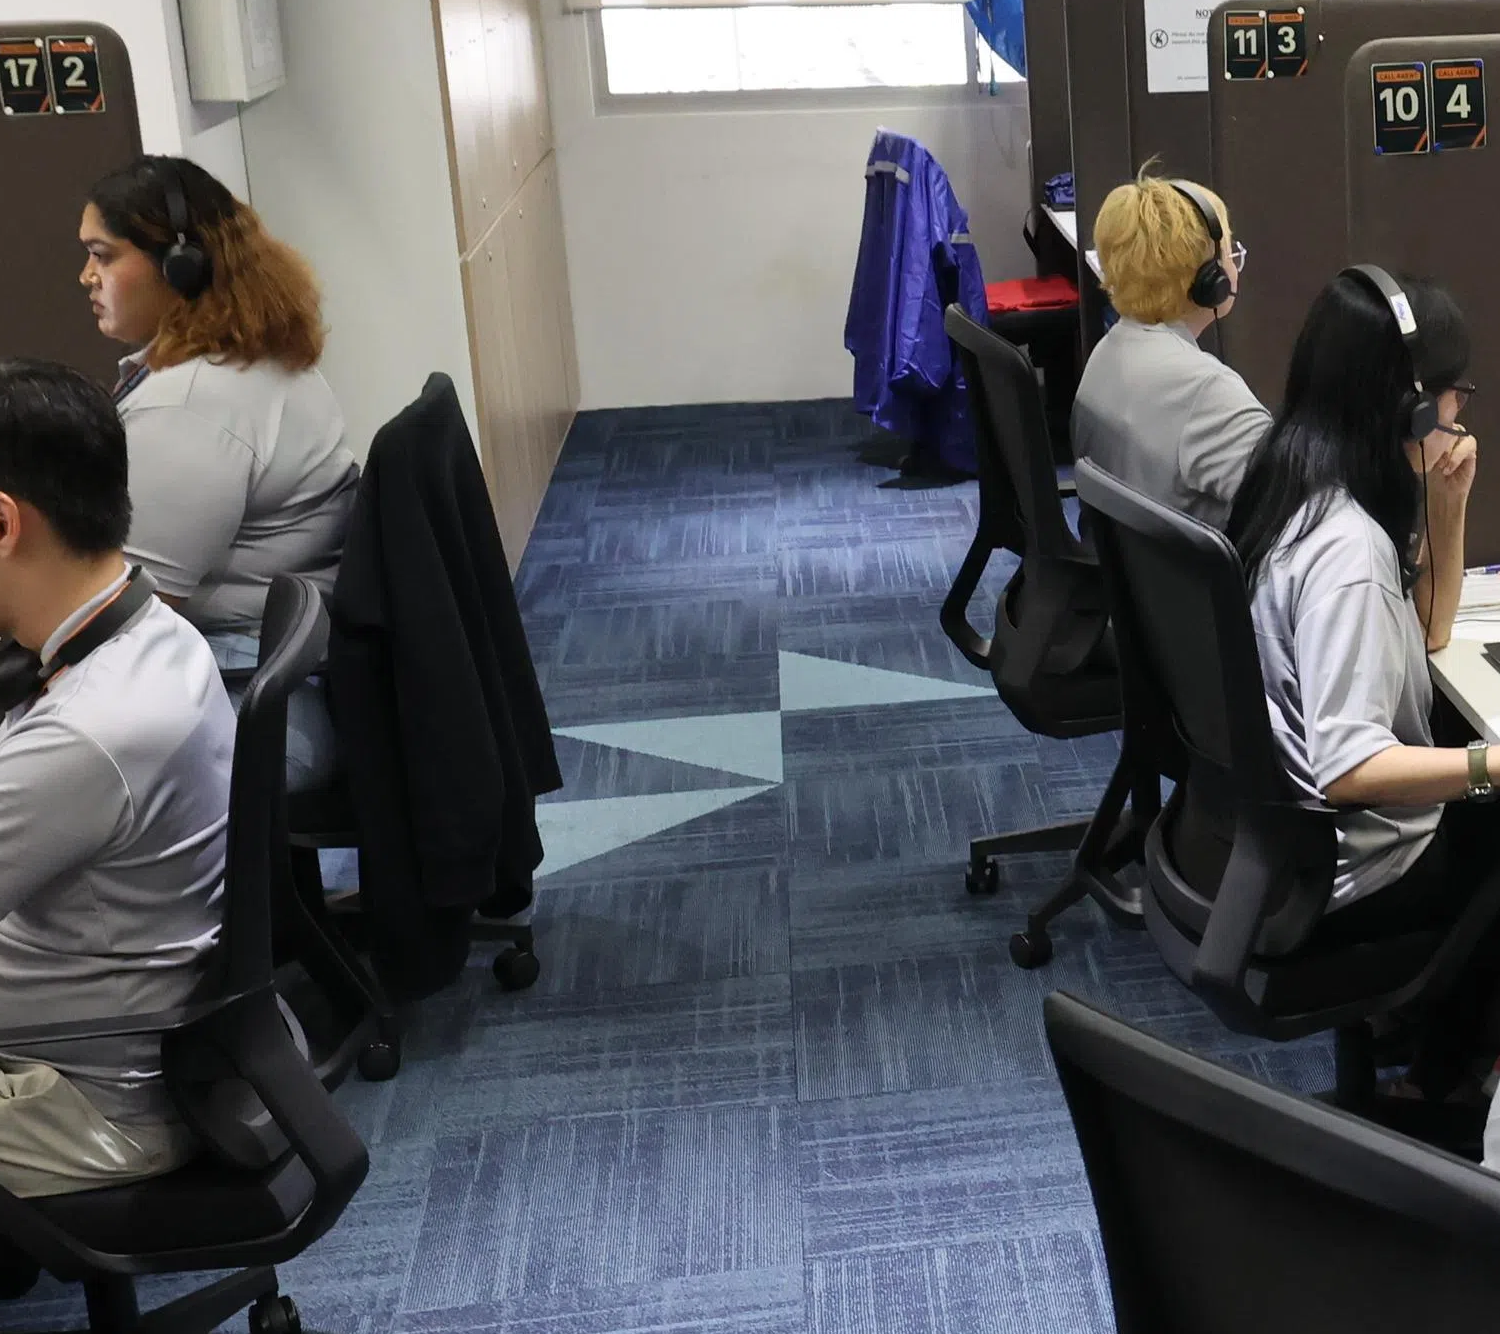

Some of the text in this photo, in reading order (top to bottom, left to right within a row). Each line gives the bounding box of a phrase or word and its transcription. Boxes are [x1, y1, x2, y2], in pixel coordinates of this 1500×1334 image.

[1233, 29, 1257, 55] 11
[1277, 26, 1296, 54] 3
[3, 58, 38, 87] 17
[62, 55, 88, 87] 2
[1379, 86, 1419, 122] 10
[1446, 84, 1471, 118] 4
